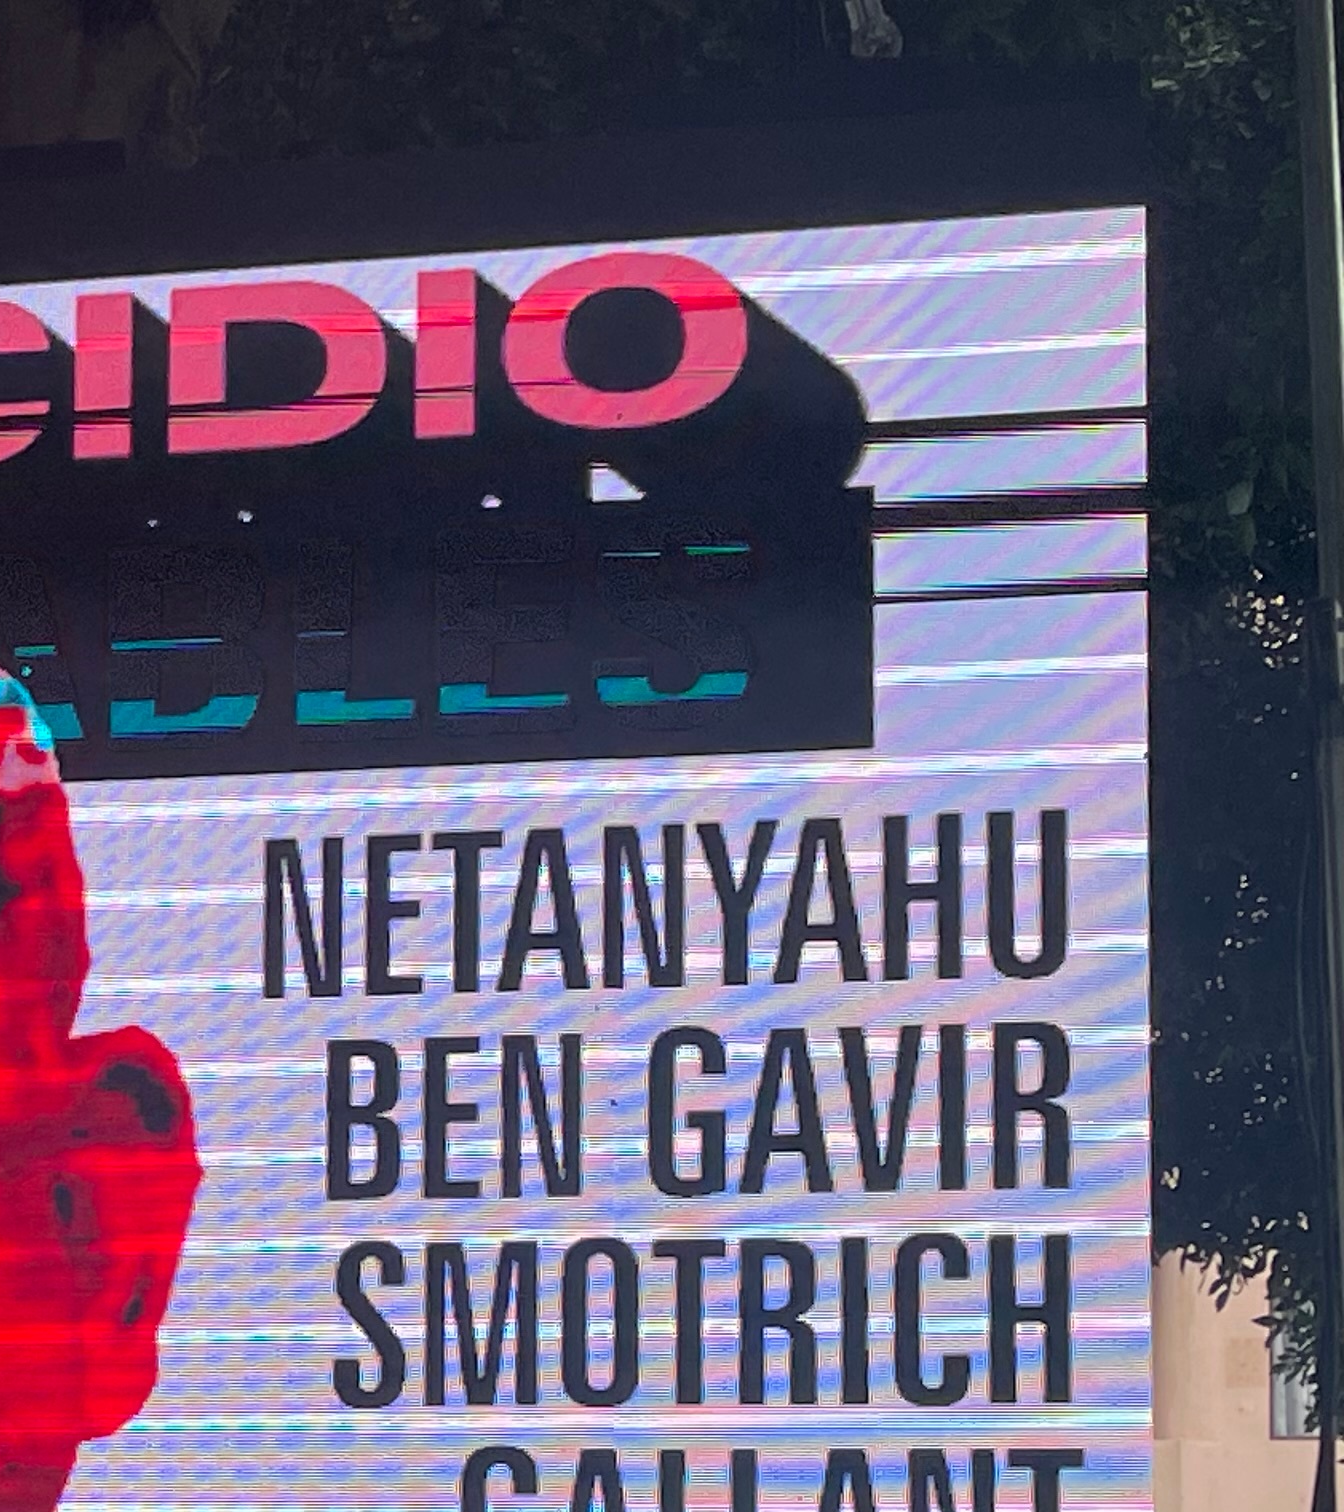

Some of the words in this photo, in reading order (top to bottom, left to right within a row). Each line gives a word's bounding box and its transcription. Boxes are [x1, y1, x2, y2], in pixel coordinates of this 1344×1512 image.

[262, 809, 1069, 999] NETANYAHU
[324, 1031, 583, 1201] BEN
[647, 1020, 1072, 1198] GAVIR
[331, 1231, 1072, 1409] SMOTRICH
